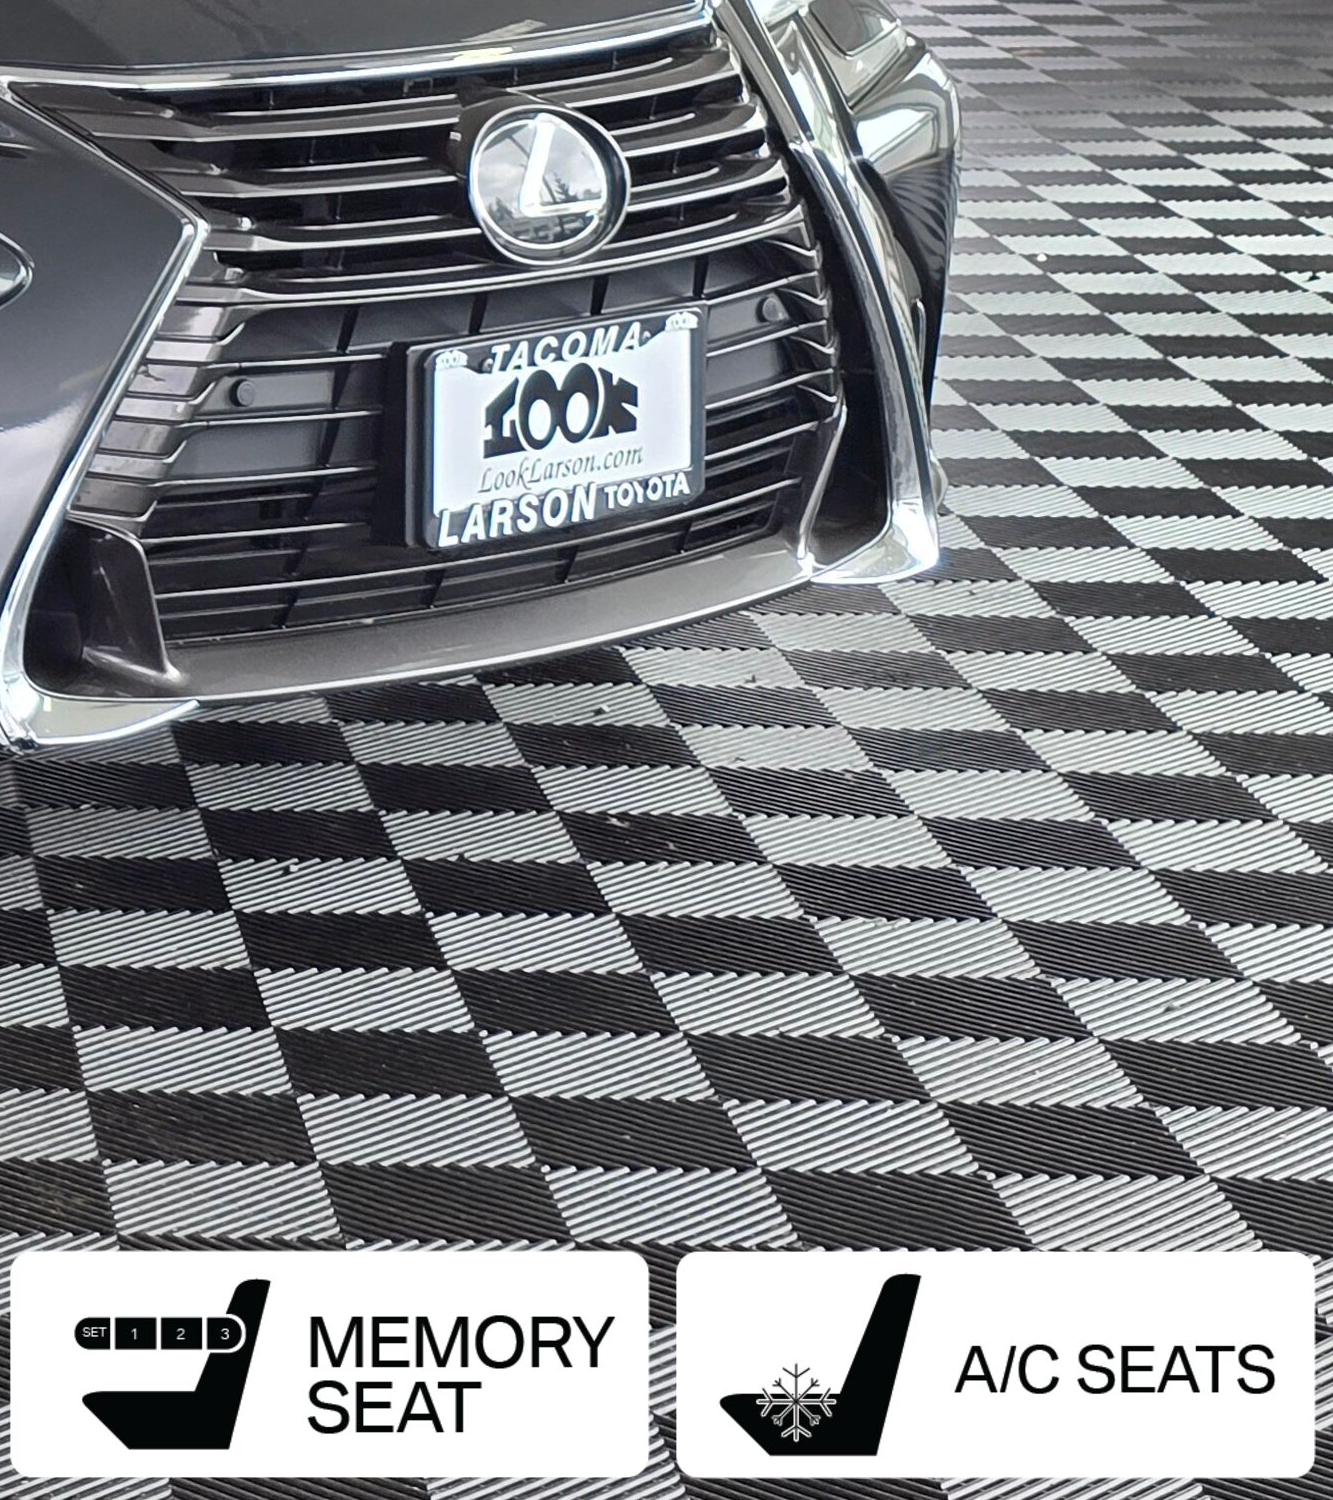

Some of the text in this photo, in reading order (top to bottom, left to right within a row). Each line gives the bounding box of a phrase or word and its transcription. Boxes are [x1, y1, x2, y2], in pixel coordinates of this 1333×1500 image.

[489, 321, 643, 376] TACOMA
[483, 362, 639, 459] LOOK
[477, 445, 645, 494] LookLarson.com
[437, 471, 691, 548] LARSON TOYOTA
